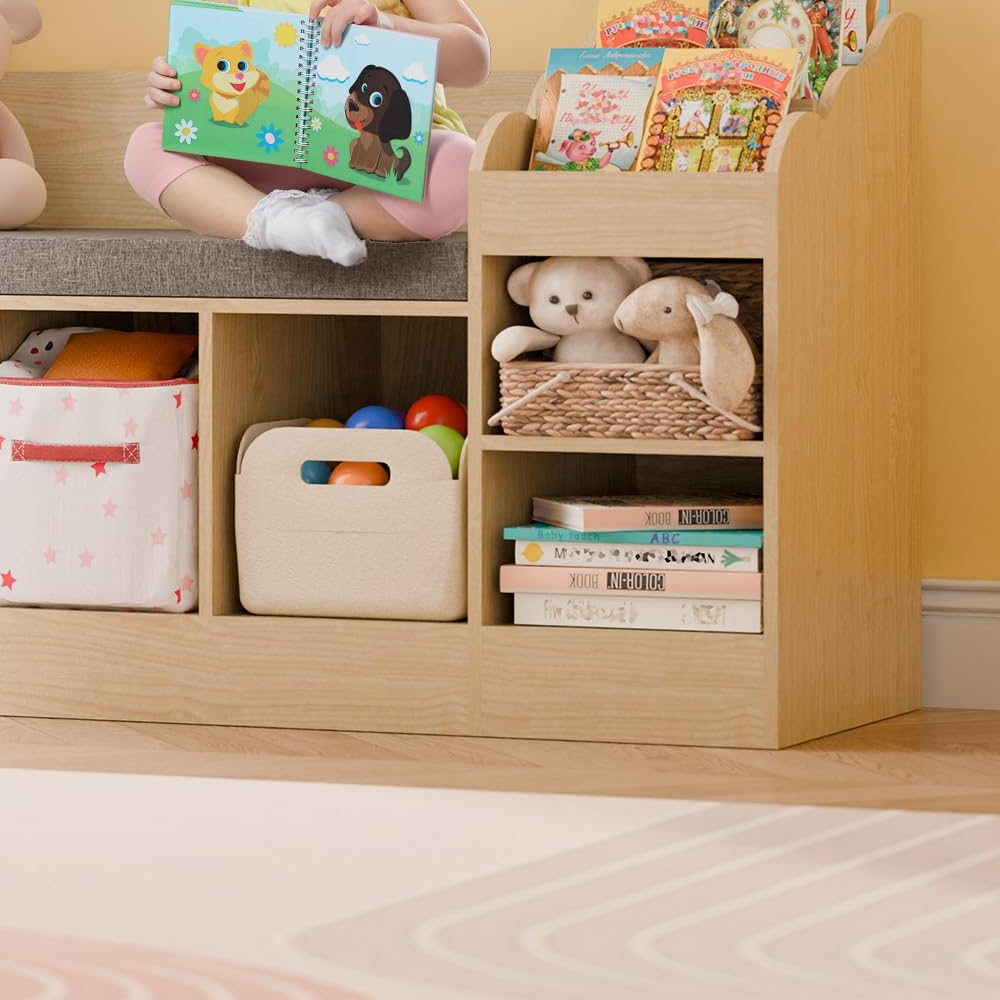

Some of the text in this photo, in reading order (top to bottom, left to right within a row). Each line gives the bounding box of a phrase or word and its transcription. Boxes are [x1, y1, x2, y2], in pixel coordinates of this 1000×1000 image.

[645, 511, 671, 525] BOOK
[650, 533, 680, 544] ABC
[569, 573, 598, 589] BOOK
